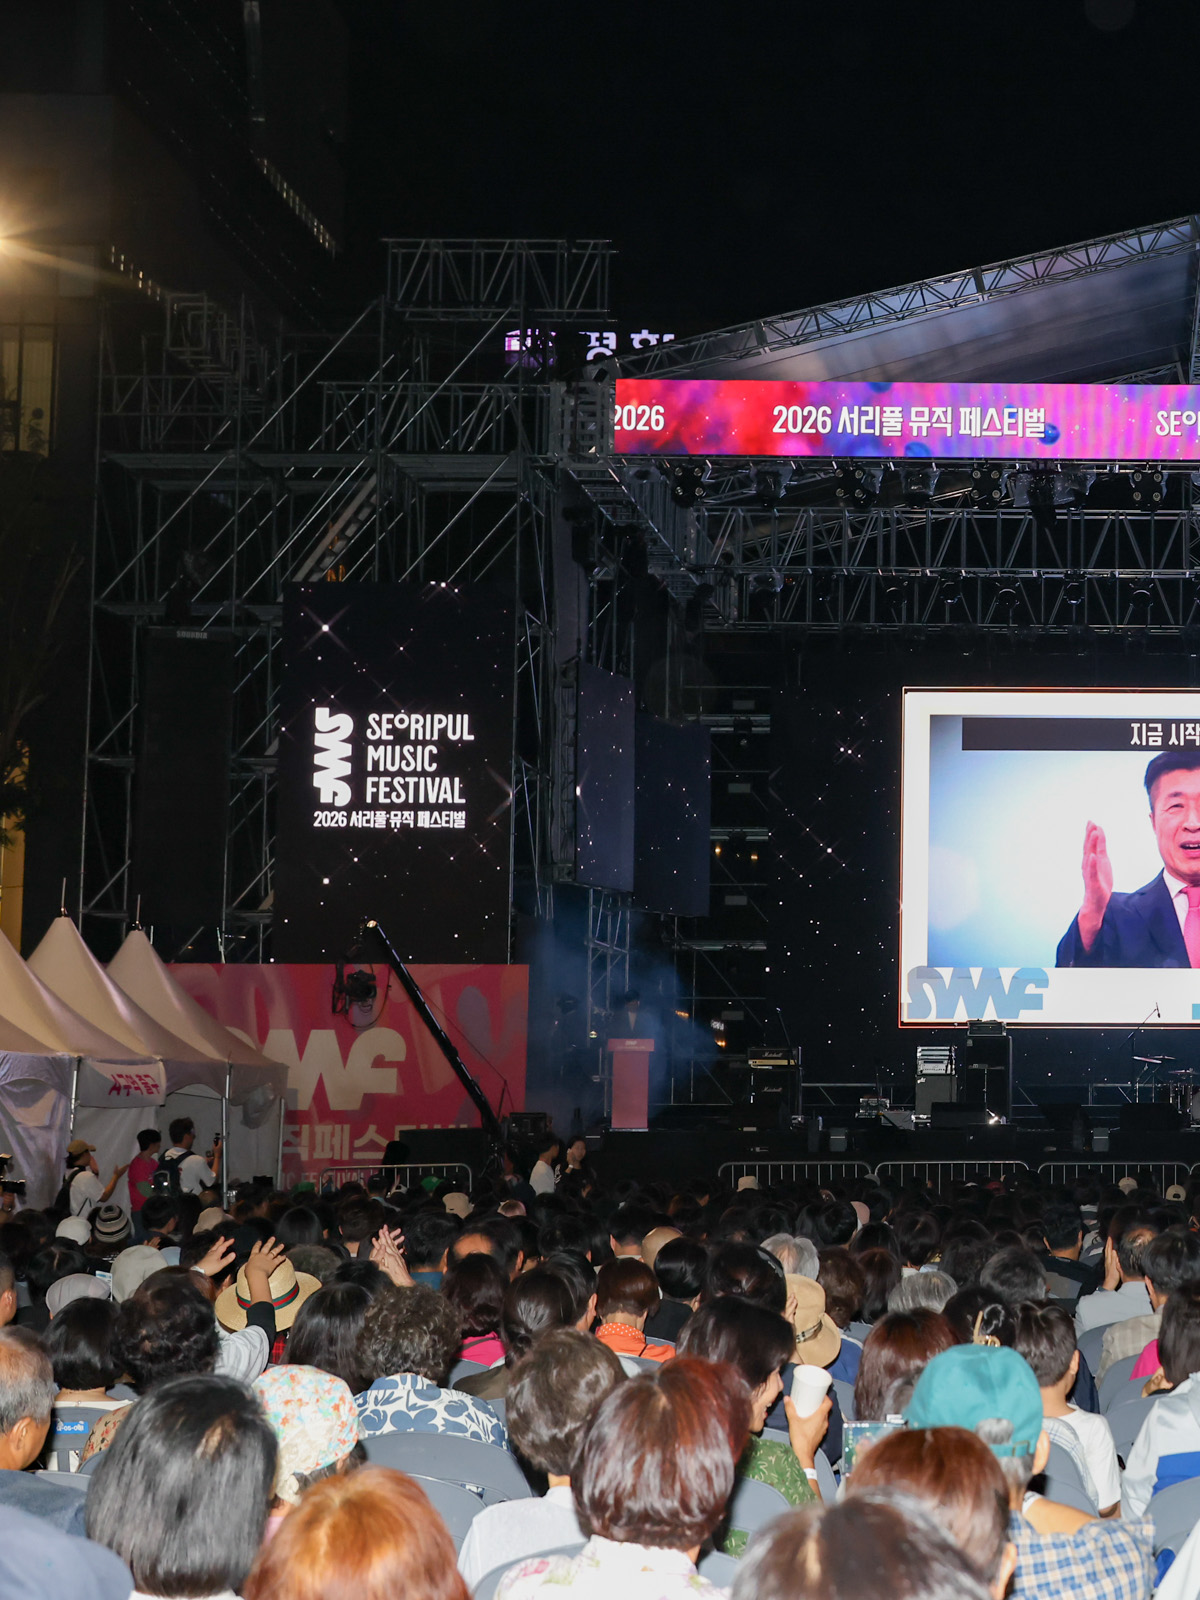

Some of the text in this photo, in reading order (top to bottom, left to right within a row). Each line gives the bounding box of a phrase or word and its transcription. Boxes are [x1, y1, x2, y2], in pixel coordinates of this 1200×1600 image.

[614, 405, 665, 431] 2026
[773, 406, 1045, 438] 2026 서리풀 뮤직 페스티벌
[1130, 722, 1164, 746] 지금
[366, 745, 438, 772] MUSIC
[366, 776, 467, 804] FESTIVAL
[313, 810, 467, 829] 2026 서리풀 뮤직 페스티벌
